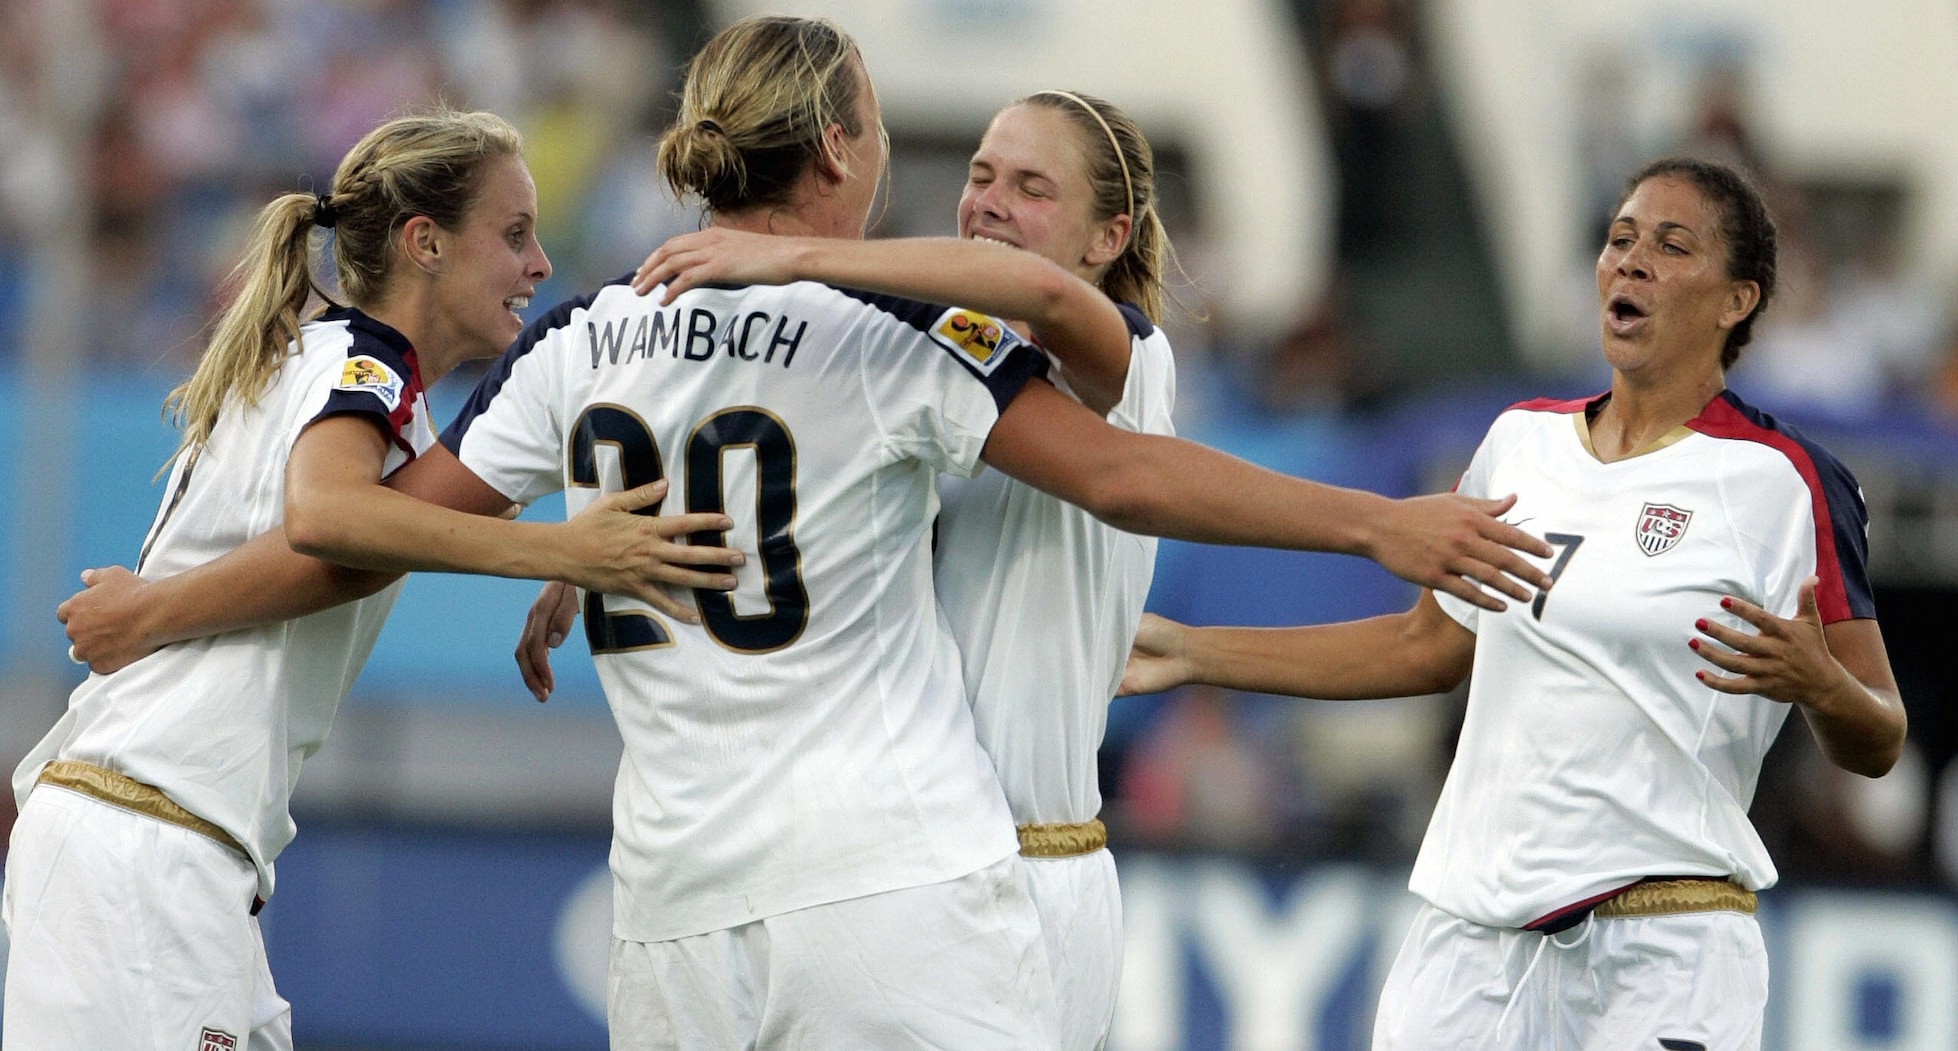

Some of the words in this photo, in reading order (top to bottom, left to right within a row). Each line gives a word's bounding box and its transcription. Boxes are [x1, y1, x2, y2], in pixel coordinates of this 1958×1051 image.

[587, 307, 808, 369] WAMBACH
[568, 402, 810, 655] 20
[1532, 531, 1585, 622] 7
